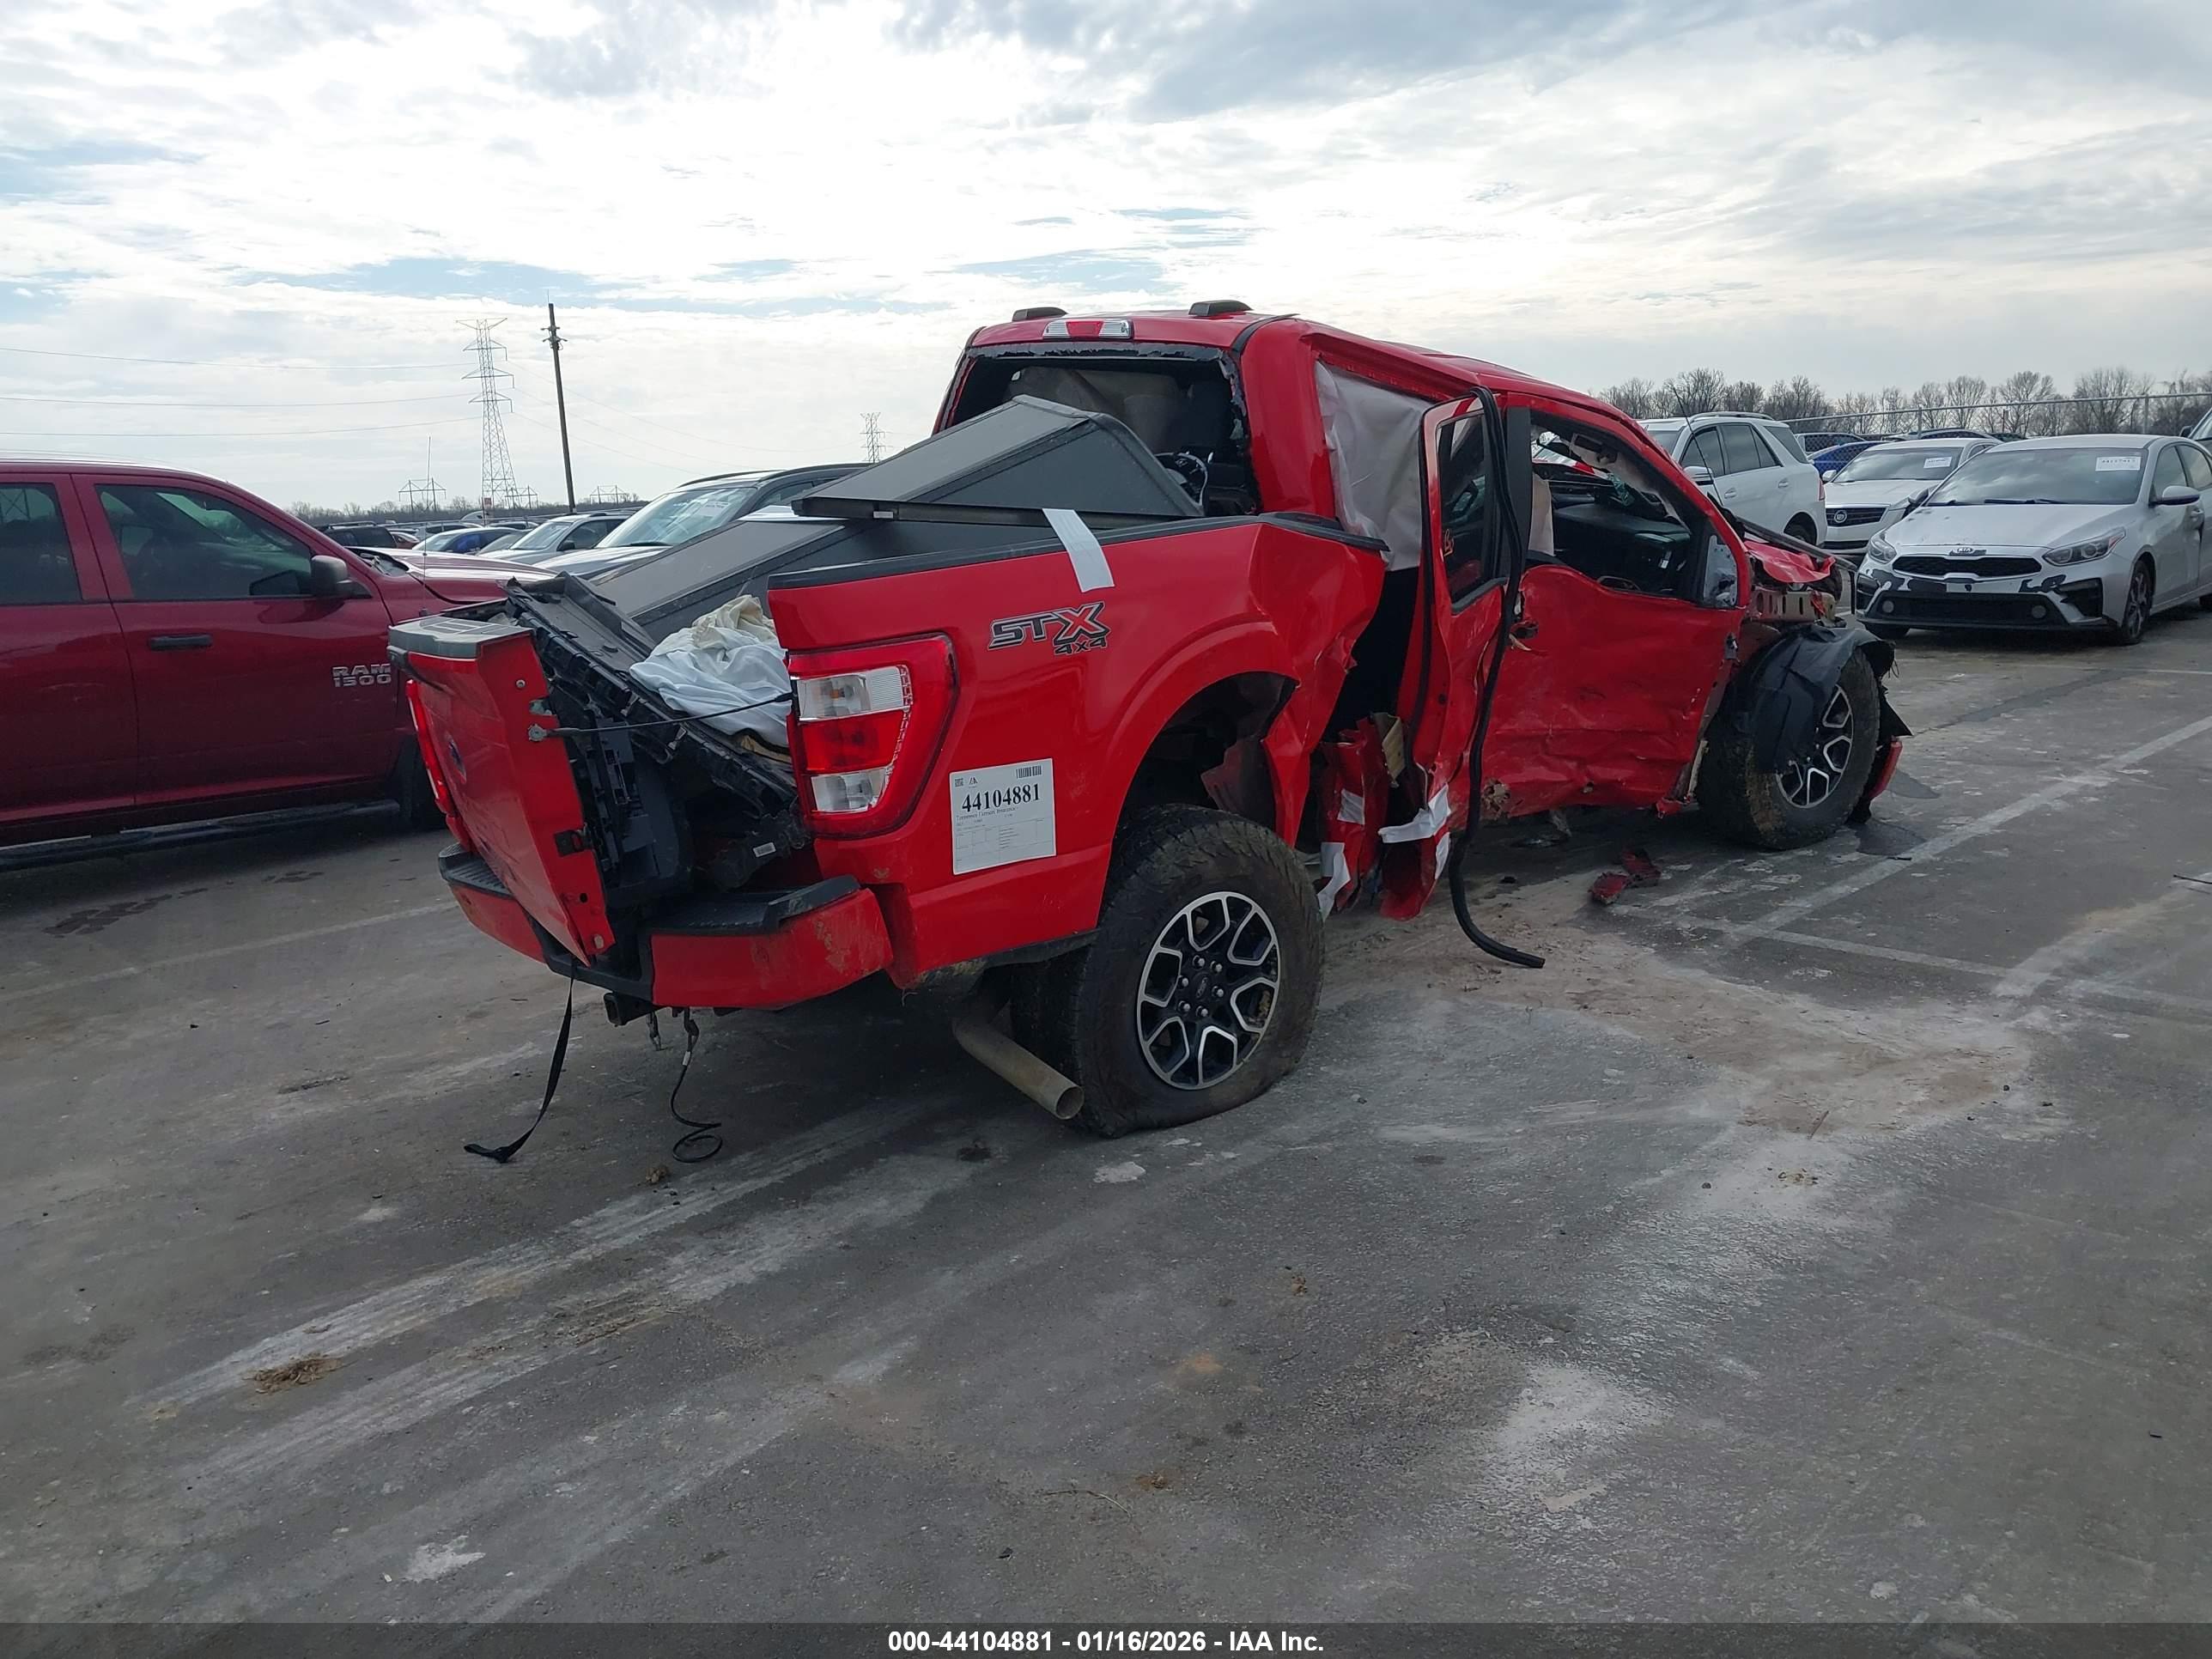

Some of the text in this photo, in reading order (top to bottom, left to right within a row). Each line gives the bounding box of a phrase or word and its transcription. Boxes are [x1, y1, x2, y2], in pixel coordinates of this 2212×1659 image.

[988, 601, 1110, 650] STX
[332, 663, 392, 677] RAM
[333, 673, 392, 688] 1500
[962, 783, 1040, 812] 44104881
